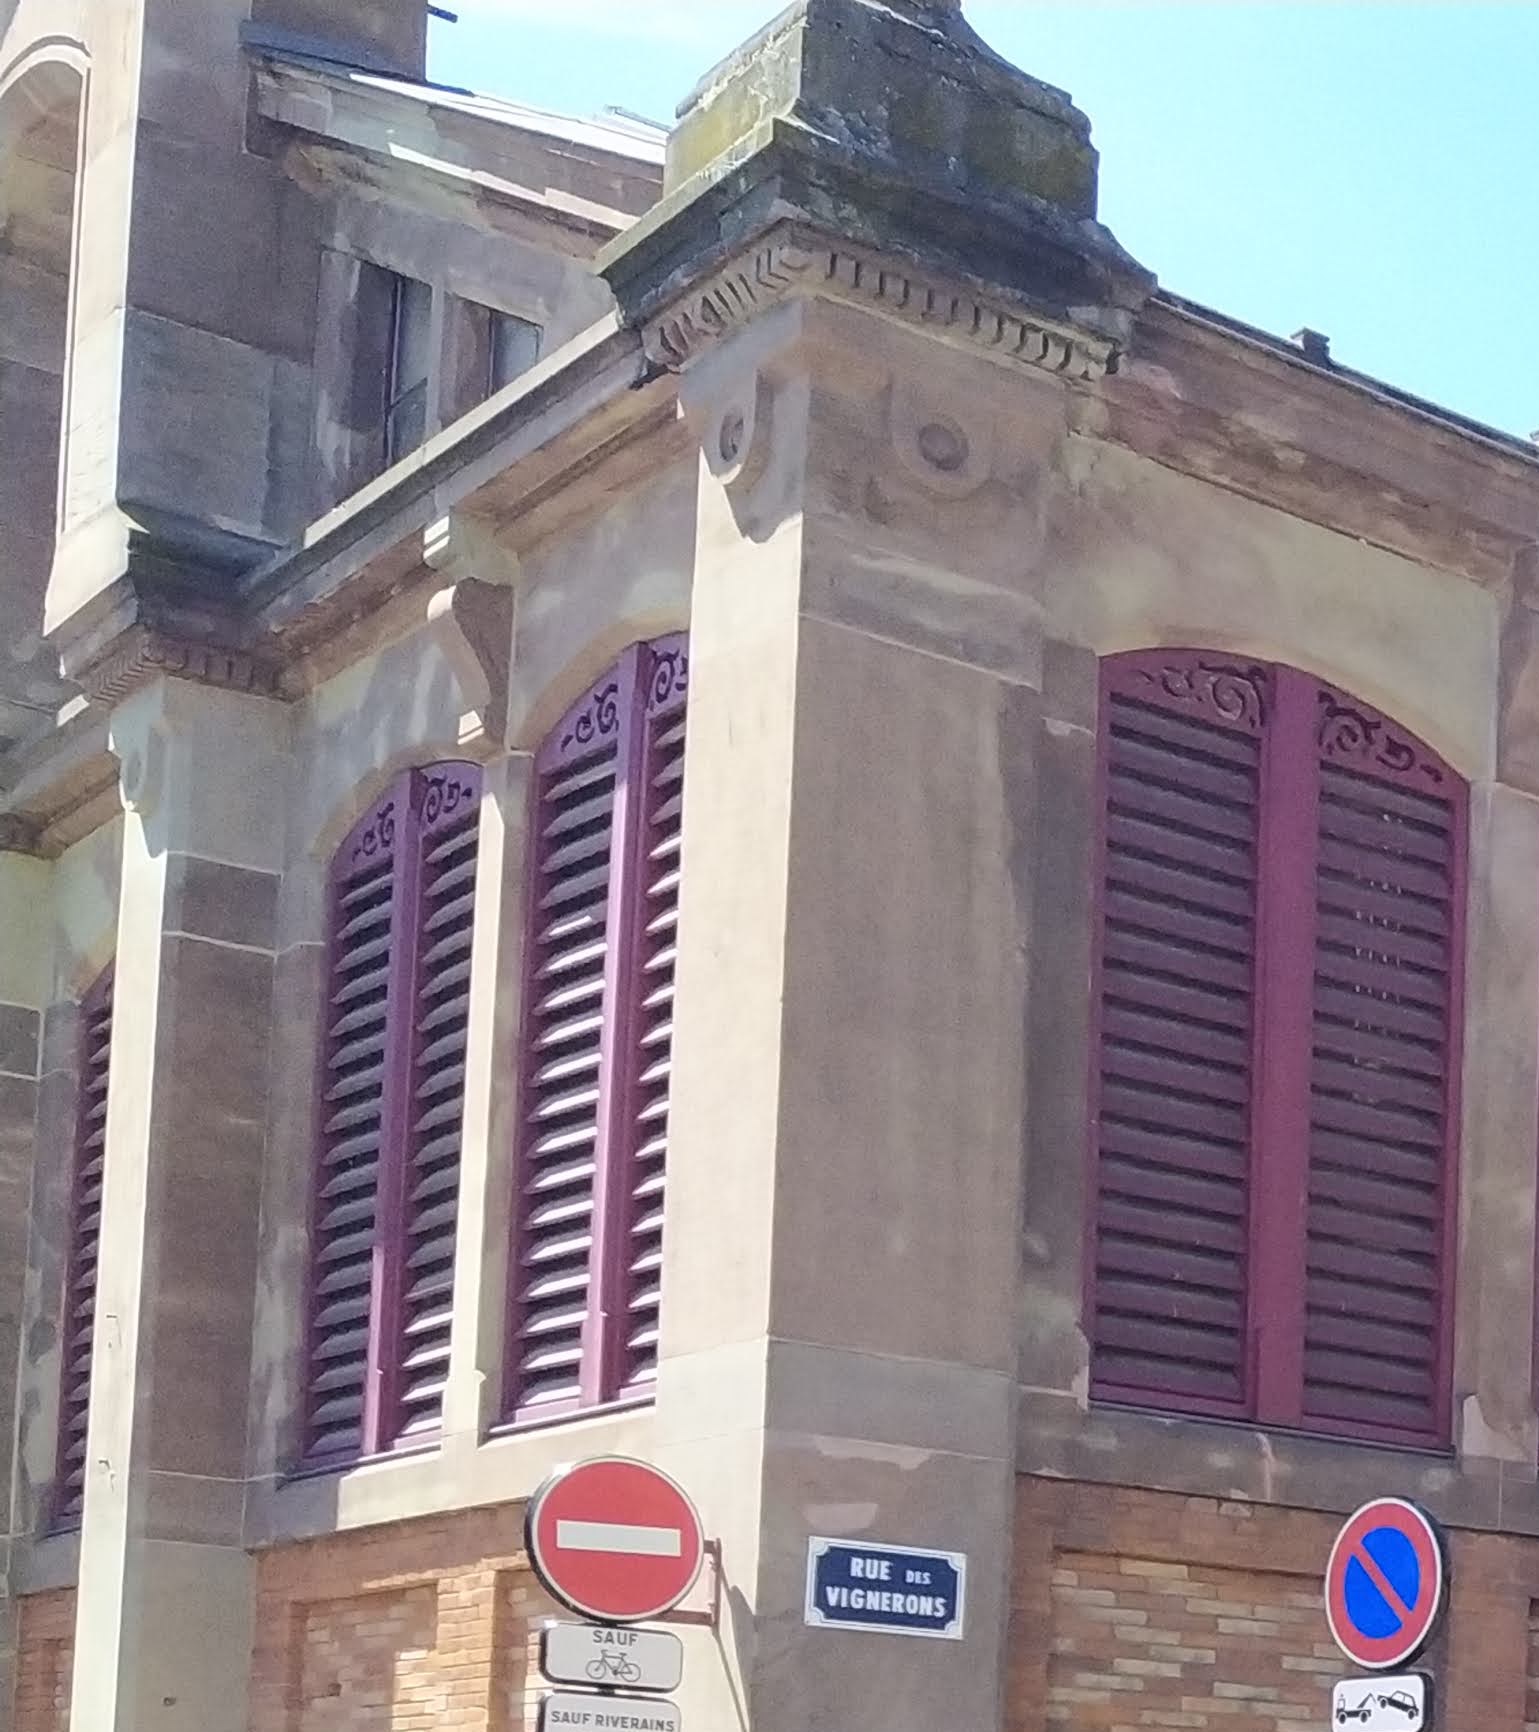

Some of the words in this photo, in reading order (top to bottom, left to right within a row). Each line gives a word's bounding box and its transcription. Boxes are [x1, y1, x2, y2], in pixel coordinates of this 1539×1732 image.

[849, 1556, 894, 1581] RUE
[904, 1569, 933, 1585] DES
[825, 1586, 947, 1618] VIGNERONS
[592, 1630, 638, 1647] SAUF
[551, 1710, 592, 1725] SAUF
[594, 1713, 675, 1732] RIVERAINS
